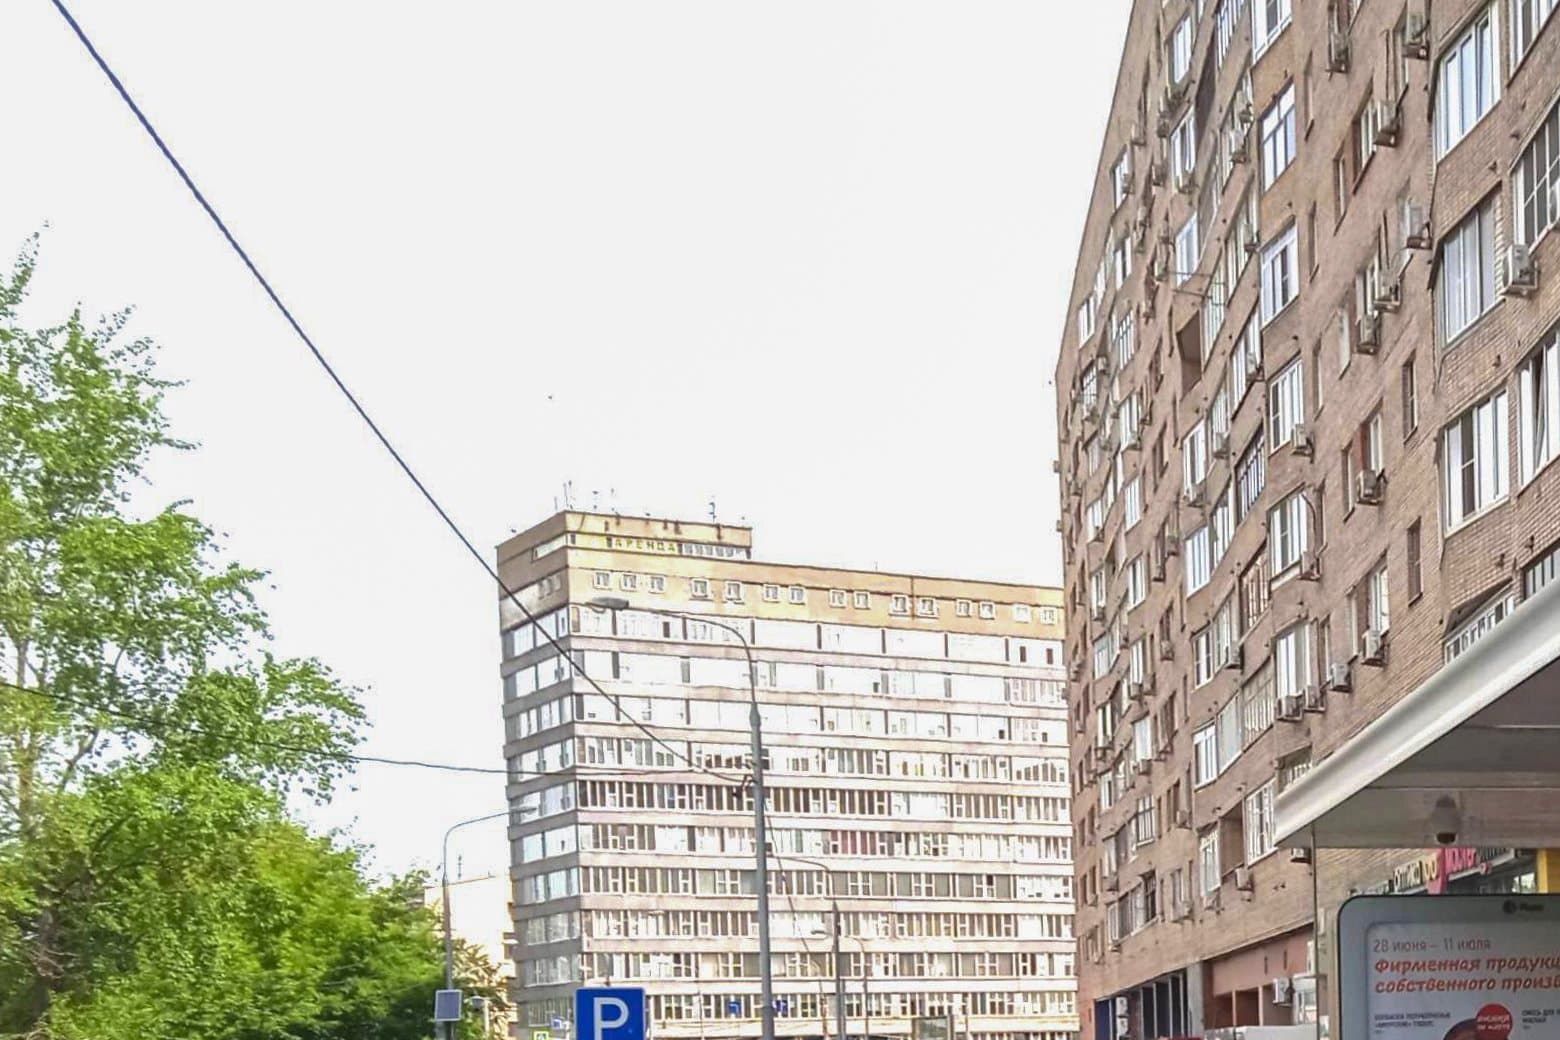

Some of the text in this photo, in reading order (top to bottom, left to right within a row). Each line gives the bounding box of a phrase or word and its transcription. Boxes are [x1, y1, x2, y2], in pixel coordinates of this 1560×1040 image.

[1373, 939, 1389, 953] 28
[1443, 938, 1453, 950] 11
[1375, 957, 1482, 976] Фирменная
[1375, 977, 1497, 994] собственного
